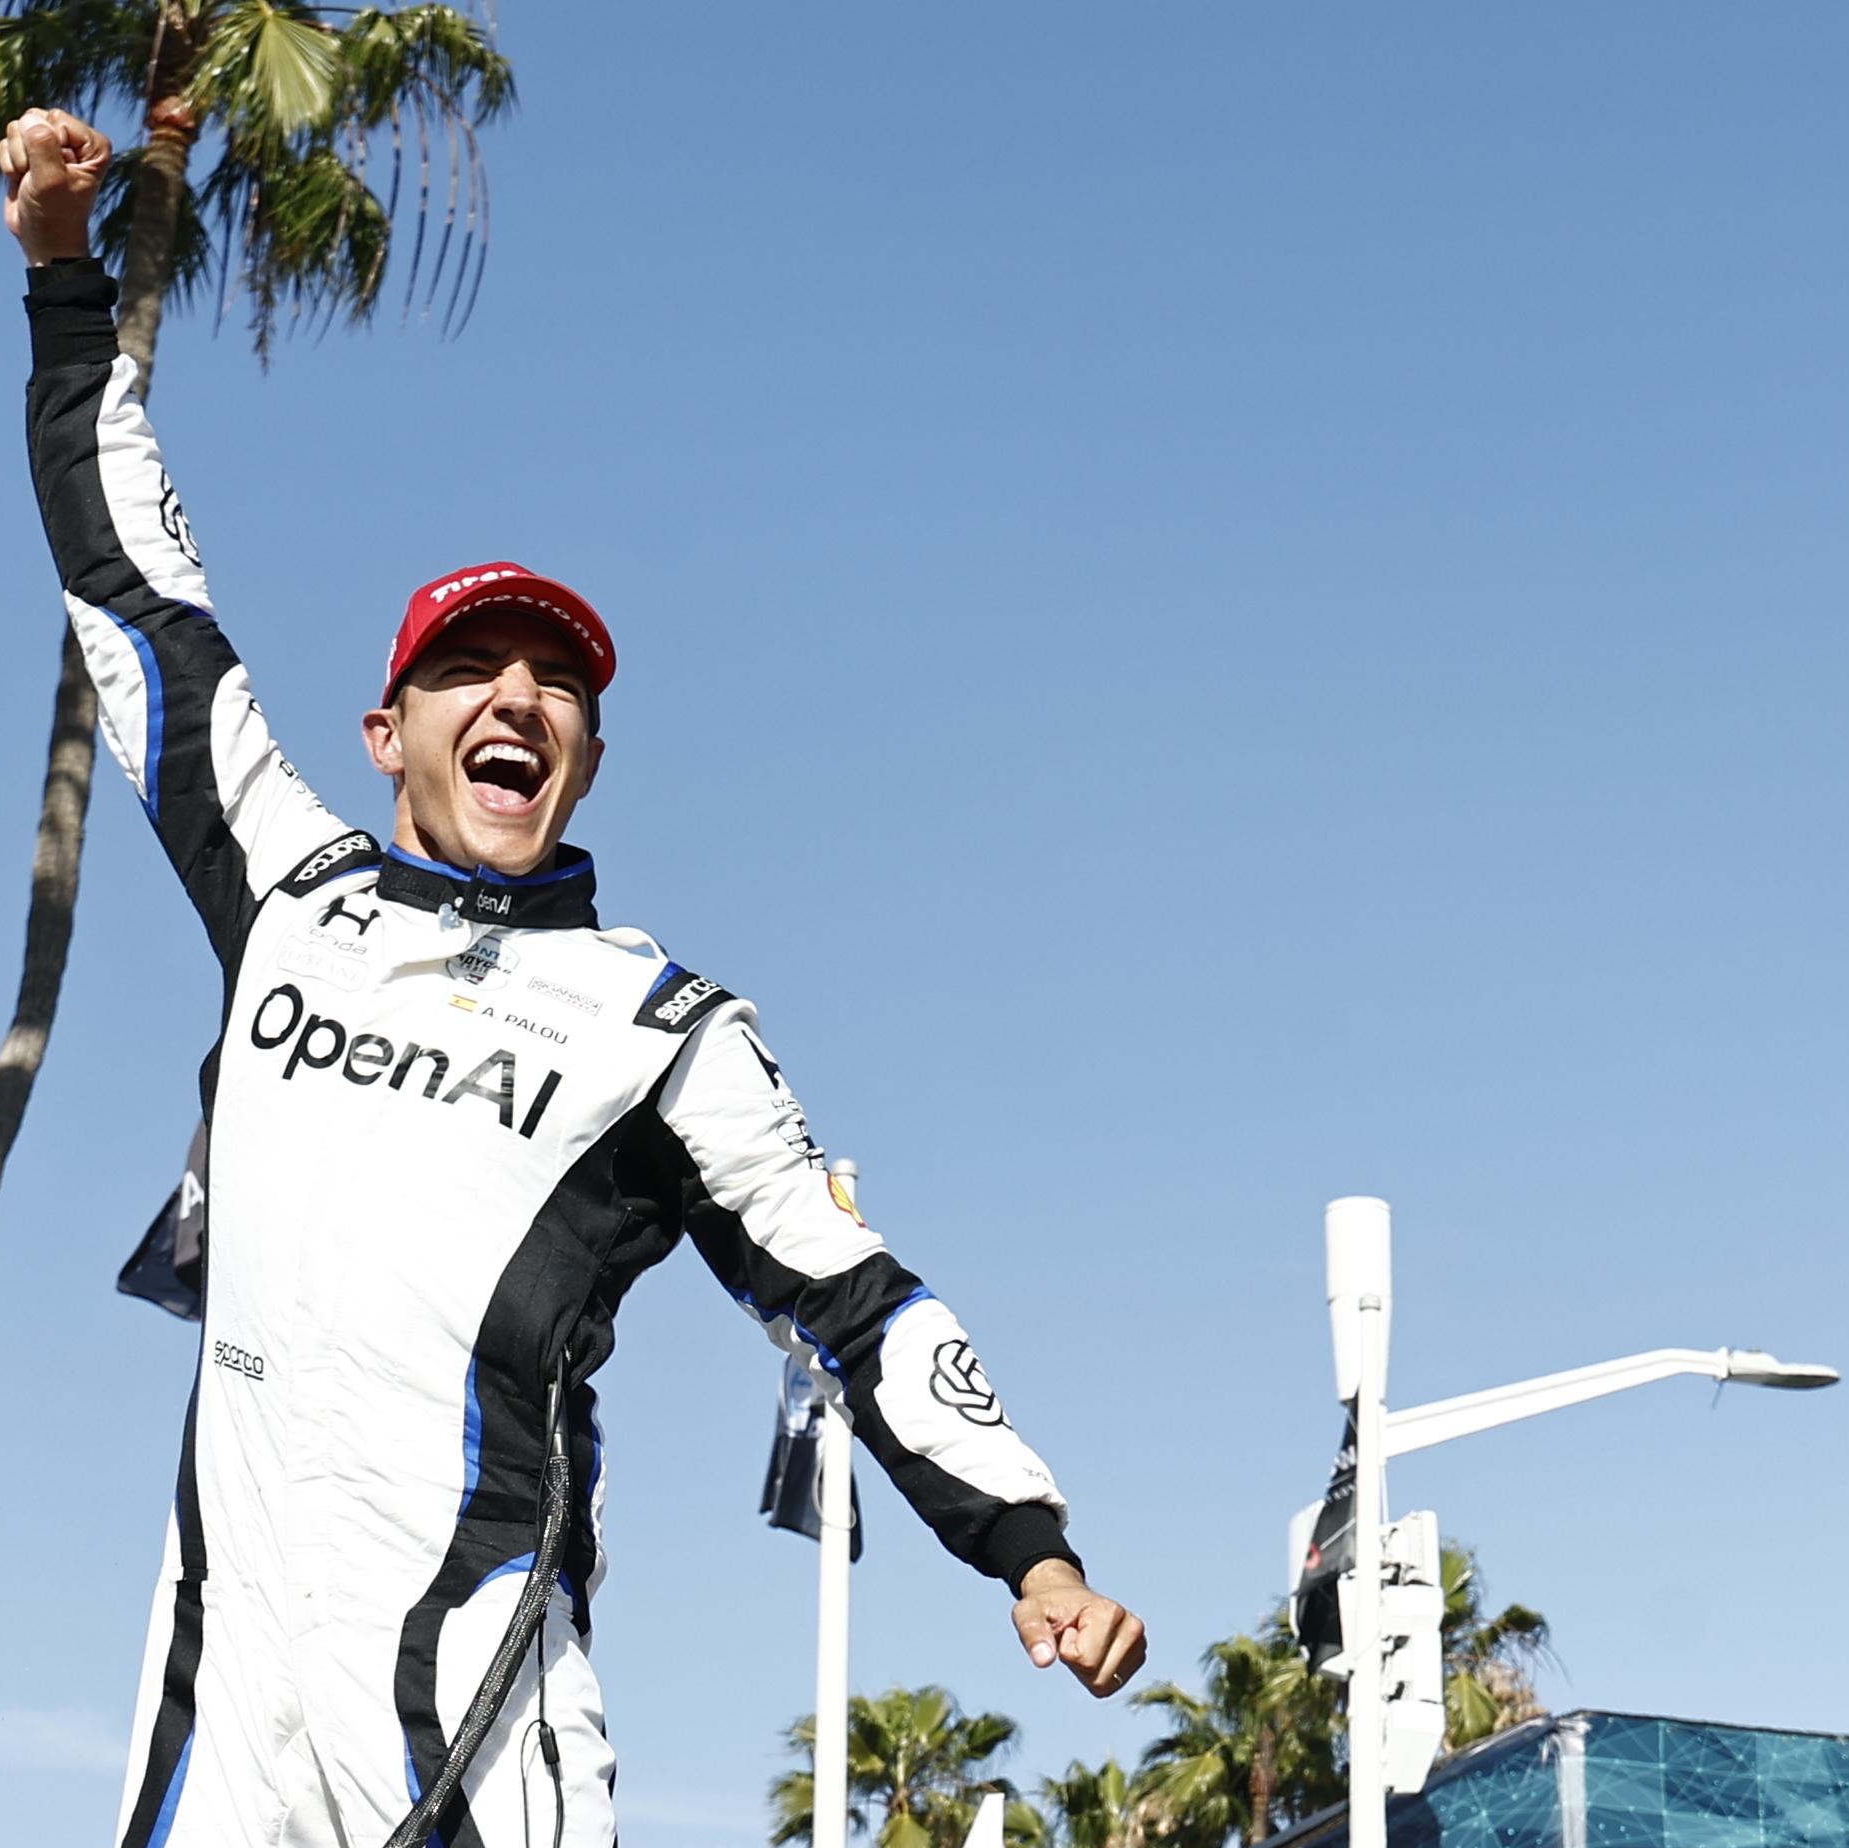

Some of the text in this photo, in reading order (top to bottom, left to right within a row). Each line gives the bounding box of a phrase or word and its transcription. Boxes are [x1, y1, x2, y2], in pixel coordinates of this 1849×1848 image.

[477, 891, 512, 916] penAI
[504, 1014, 569, 1046] PALOU
[250, 981, 563, 1141] OpenAI
[212, 1339, 265, 1377] sparco
